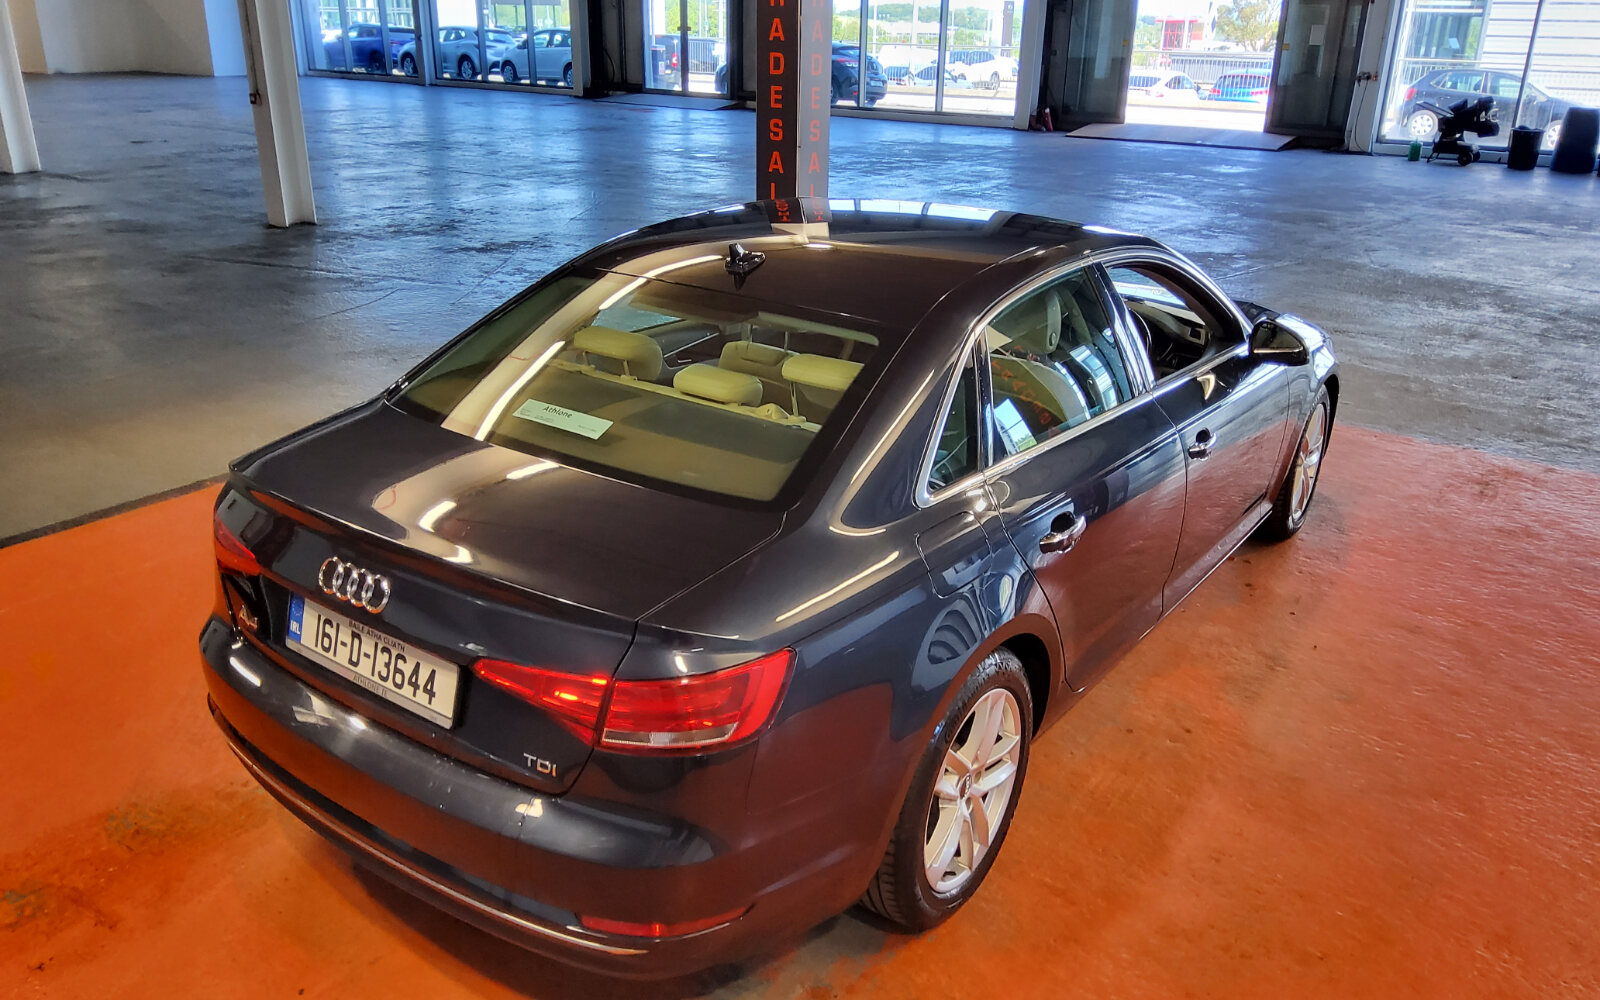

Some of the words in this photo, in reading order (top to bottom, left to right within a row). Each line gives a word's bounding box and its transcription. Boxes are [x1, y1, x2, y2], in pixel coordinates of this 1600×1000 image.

[768, 0, 785, 200] ADESA
[543, 406, 573, 419] Athlone
[290, 619, 301, 635] IRL
[314, 613, 436, 705] 161-D-13644
[523, 752, 557, 777] TDI
